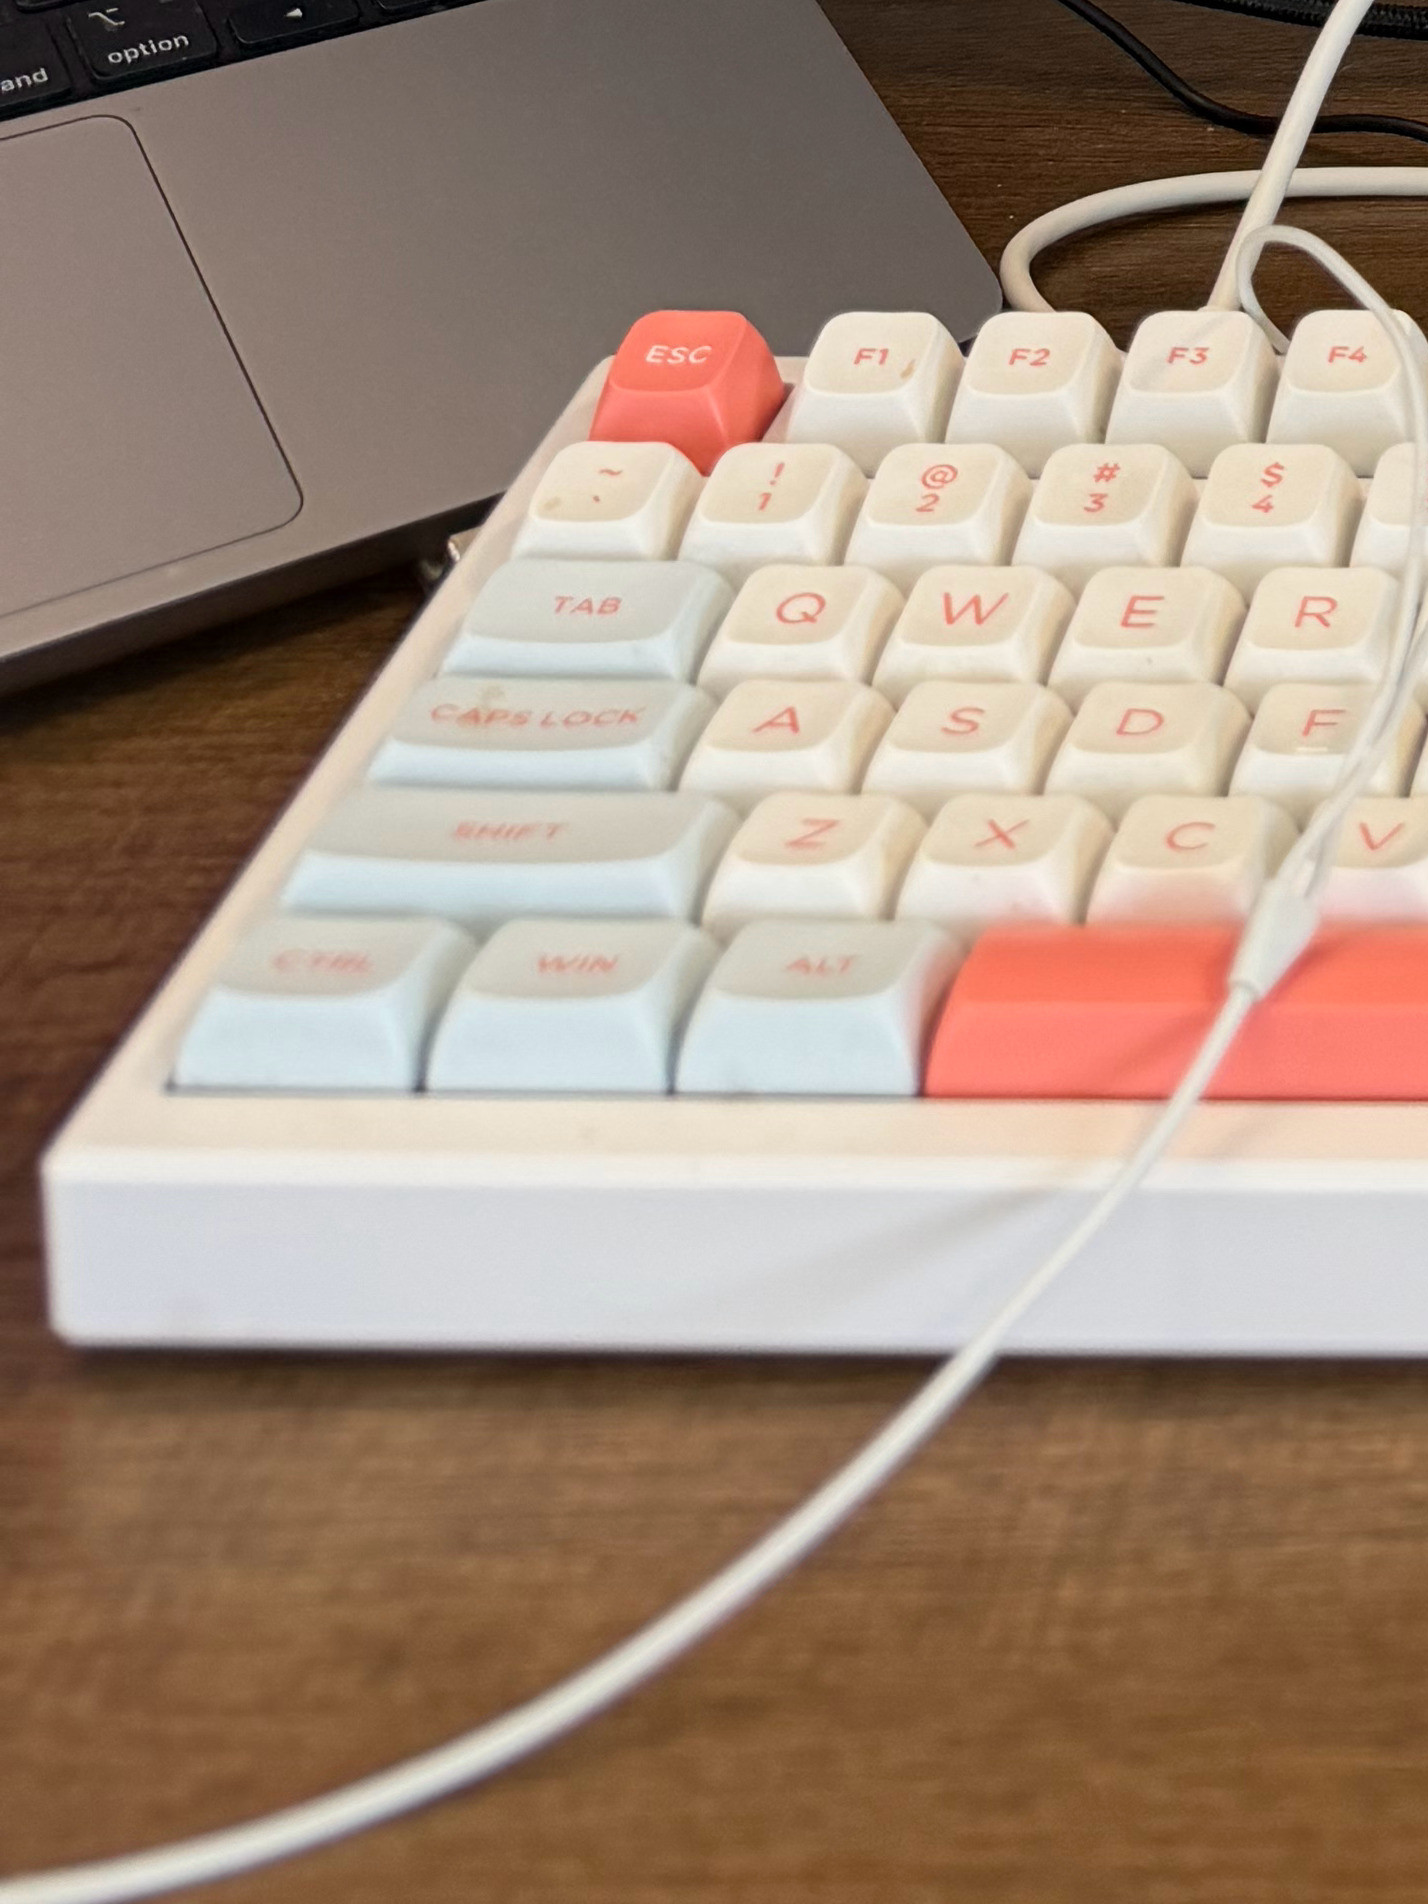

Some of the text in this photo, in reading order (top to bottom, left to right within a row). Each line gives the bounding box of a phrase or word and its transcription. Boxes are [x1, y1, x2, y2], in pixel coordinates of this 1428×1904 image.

[107, 30, 190, 66] option
[646, 344, 712, 364] ESC
[854, 348, 888, 366] F1
[1008, 348, 1051, 368] F2
[1166, 347, 1210, 366] F3
[1327, 346, 1368, 364] F4
[554, 596, 620, 617] TAB
[776, 593, 826, 625] Q
